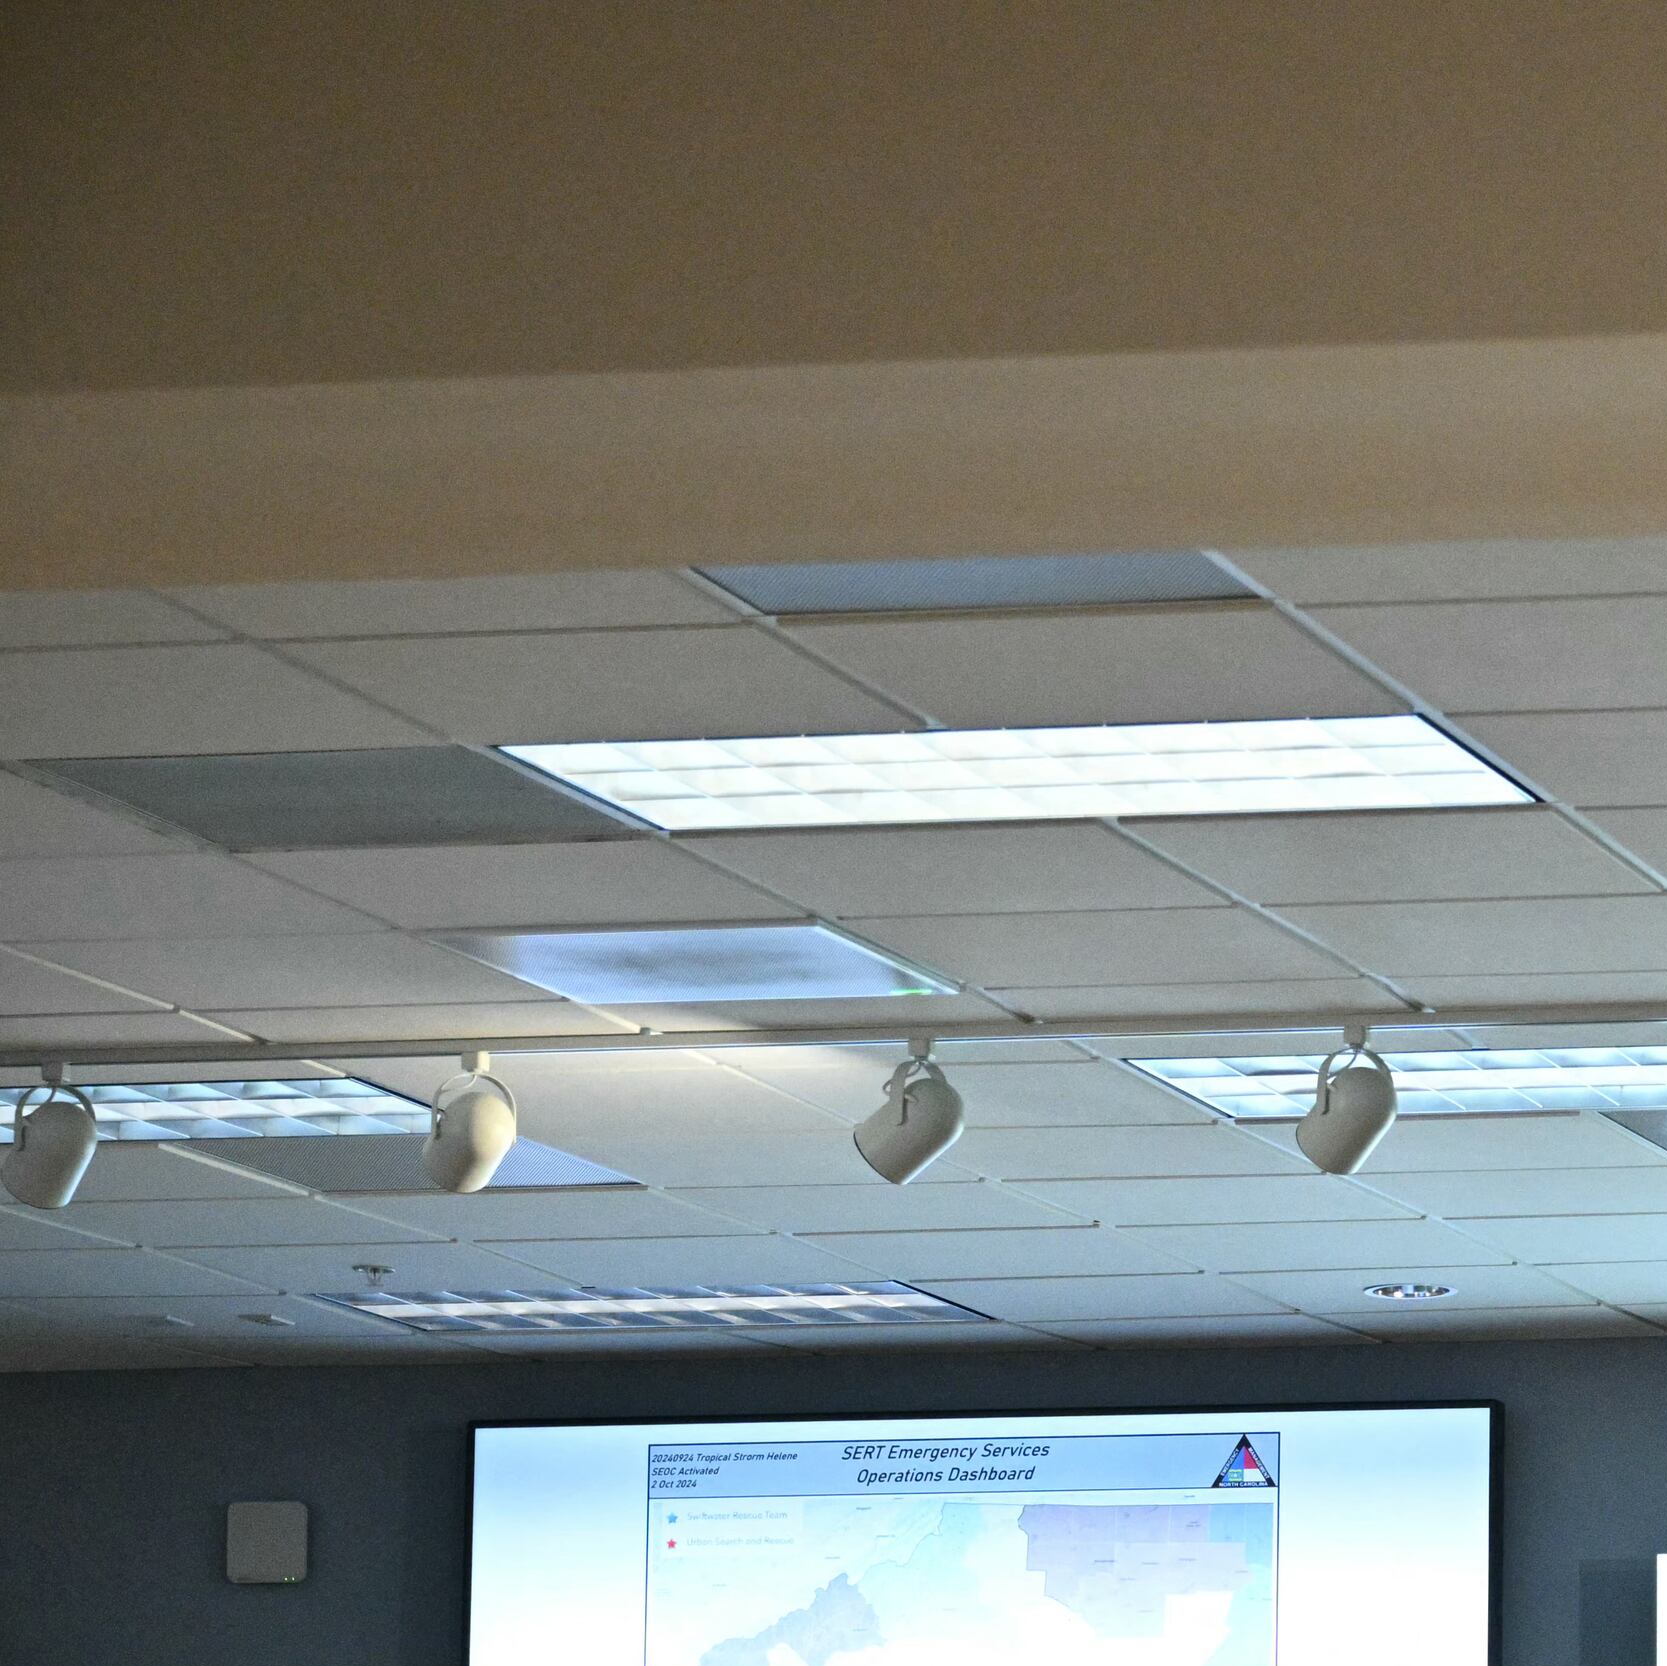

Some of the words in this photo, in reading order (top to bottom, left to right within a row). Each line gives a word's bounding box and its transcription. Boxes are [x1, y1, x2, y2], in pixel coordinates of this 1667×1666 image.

[652, 1454, 694, 1463] 20240924
[697, 1454, 731, 1463] Tropical
[733, 1453, 764, 1461] Strorm
[767, 1452, 798, 1460] Helene
[842, 1446, 886, 1460] SERT
[888, 1445, 977, 1462] Emergency
[981, 1443, 1050, 1458] Services
[652, 1468, 676, 1476] SEOC
[678, 1467, 719, 1475] Activated
[857, 1468, 944, 1486] Operations
[948, 1466, 1036, 1481] Dashboard
[651, 1480, 657, 1488] 2
[675, 1480, 697, 1488] 2024
